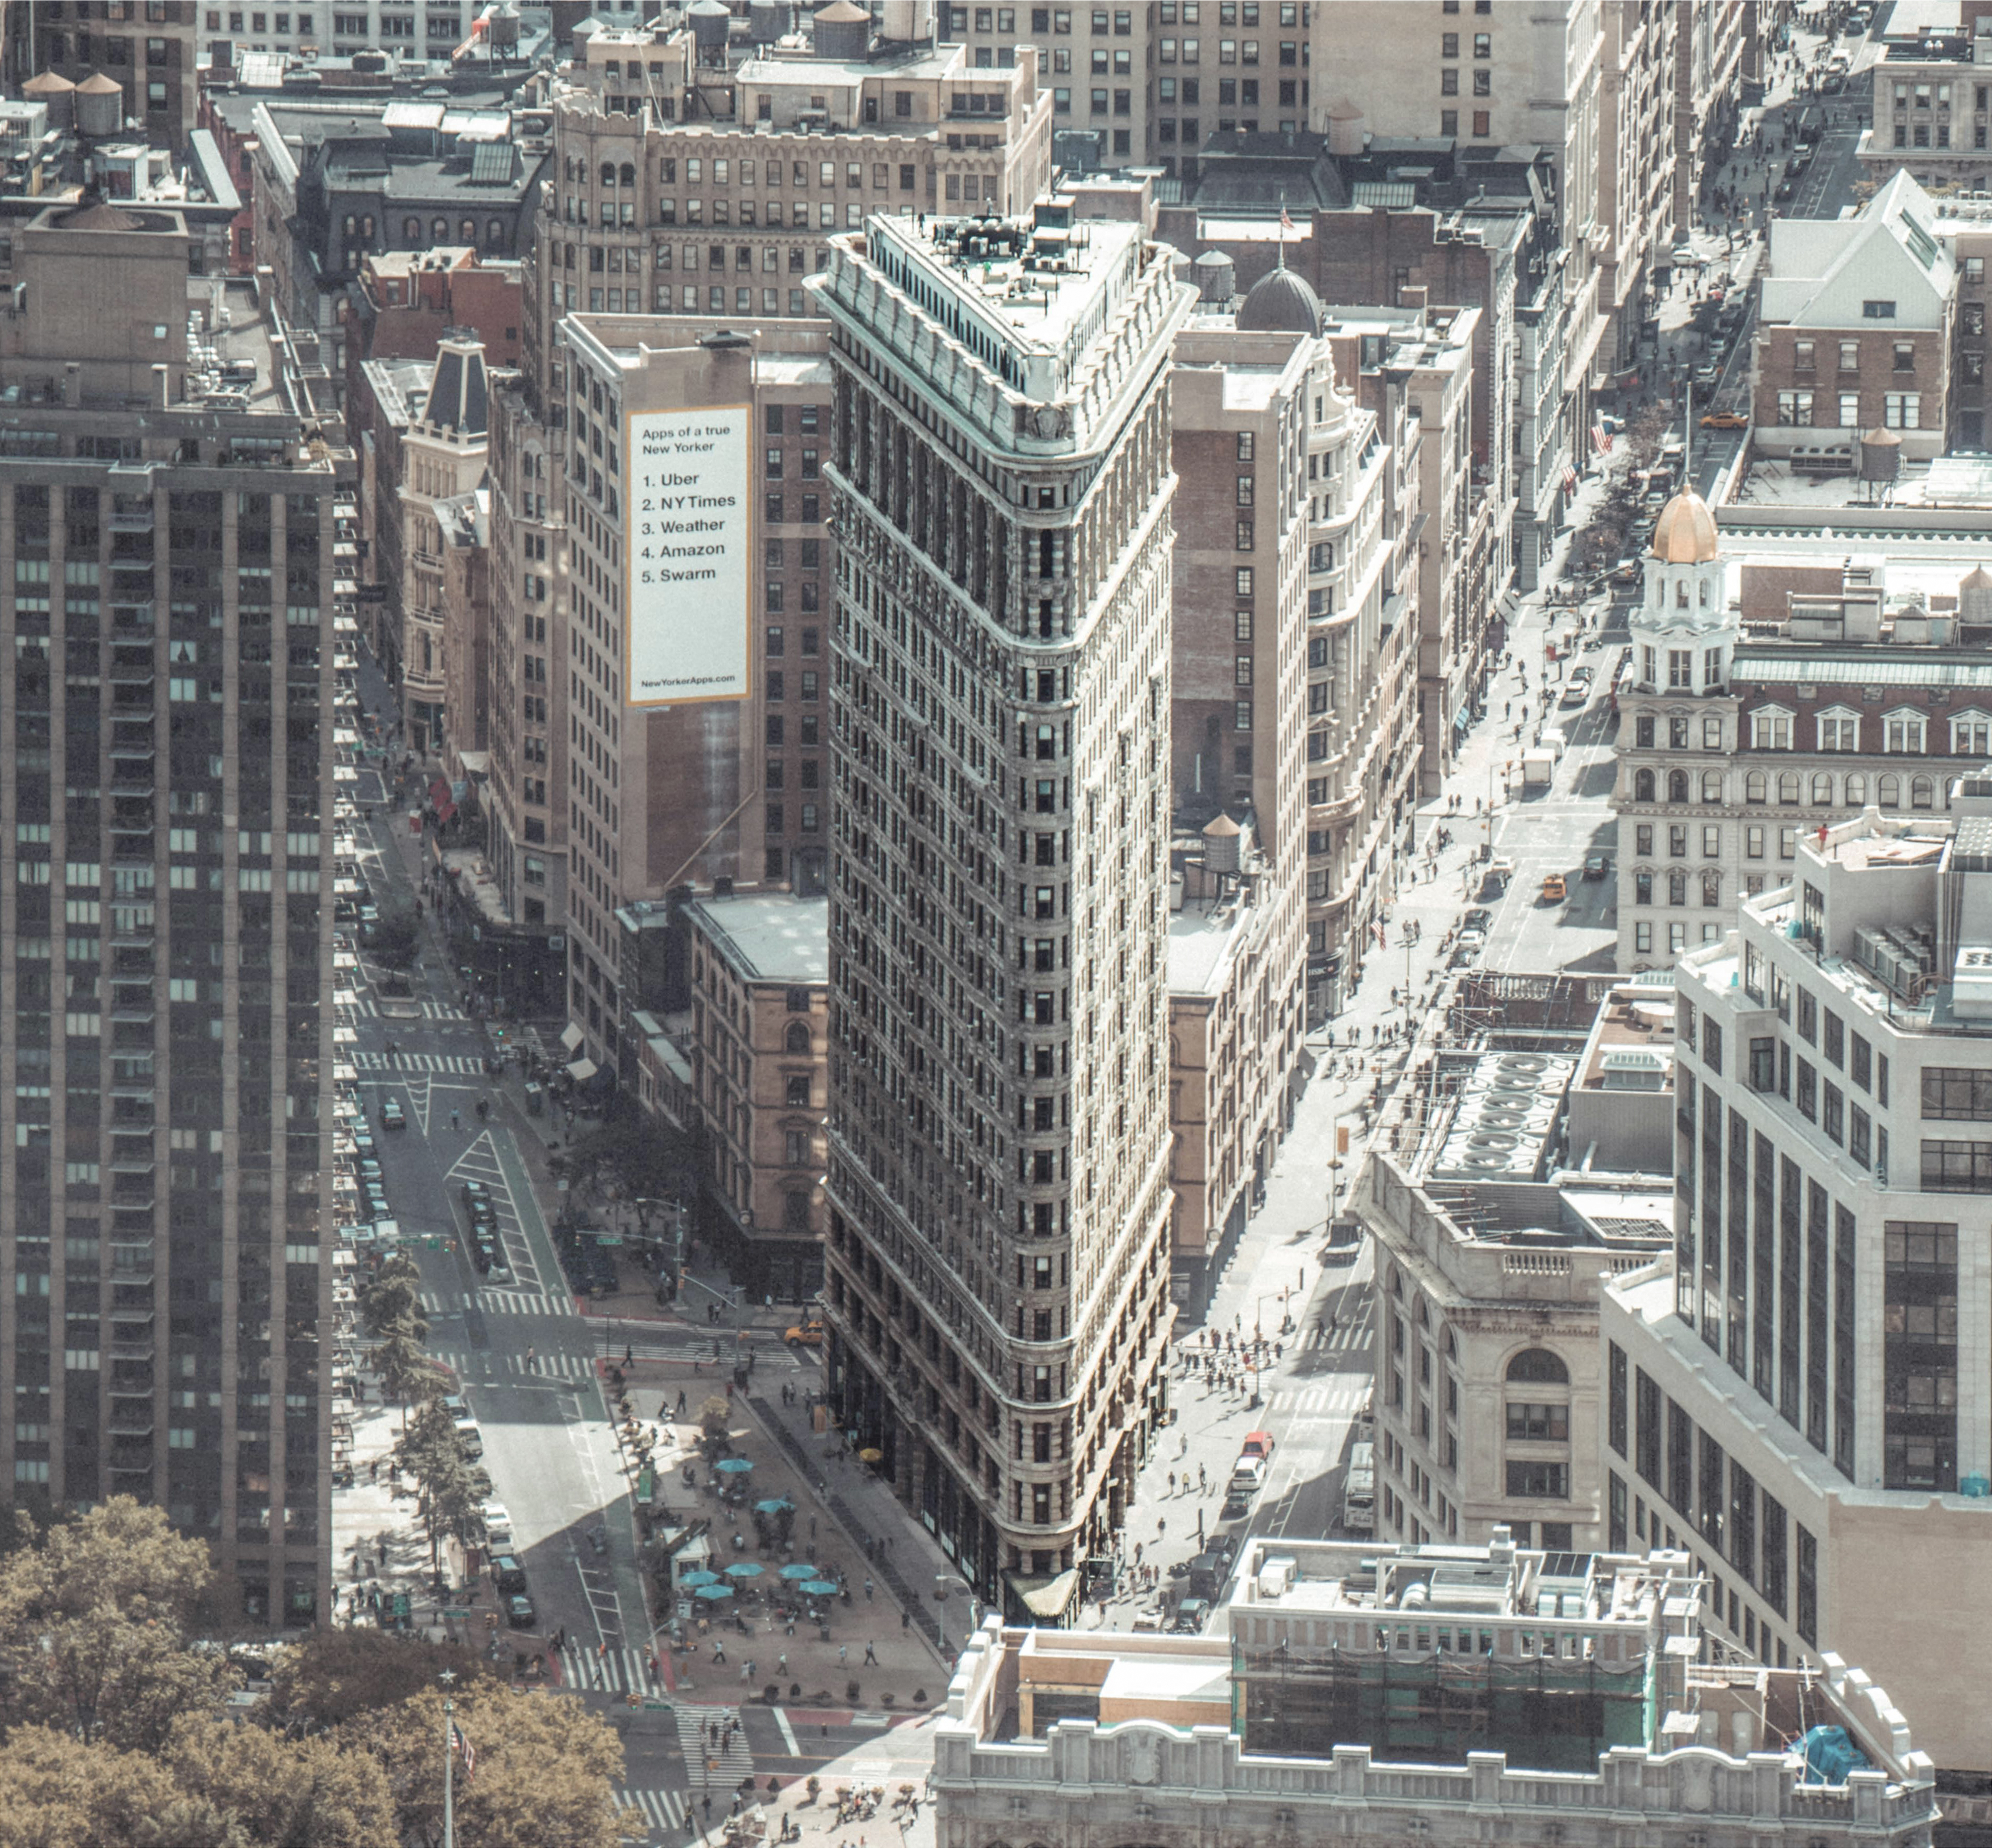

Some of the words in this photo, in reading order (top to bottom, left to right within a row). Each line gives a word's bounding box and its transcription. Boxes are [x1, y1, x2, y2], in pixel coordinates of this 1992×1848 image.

[643, 429, 674, 441] Apps
[678, 427, 690, 437] of
[706, 426, 730, 435] true
[643, 445, 670, 454] New
[674, 443, 714, 452] Yorker
[644, 475, 655, 487] 1.
[662, 473, 699, 486] Uber
[642, 499, 655, 511] 2.
[642, 523, 654, 535] 3.
[661, 519, 725, 533] Weather
[642, 547, 654, 559] 4.
[660, 545, 725, 558] Amazon
[642, 571, 654, 583] 5.
[661, 569, 715, 581] Swarm
[642, 675, 735, 687] NewYorkerApps.com
